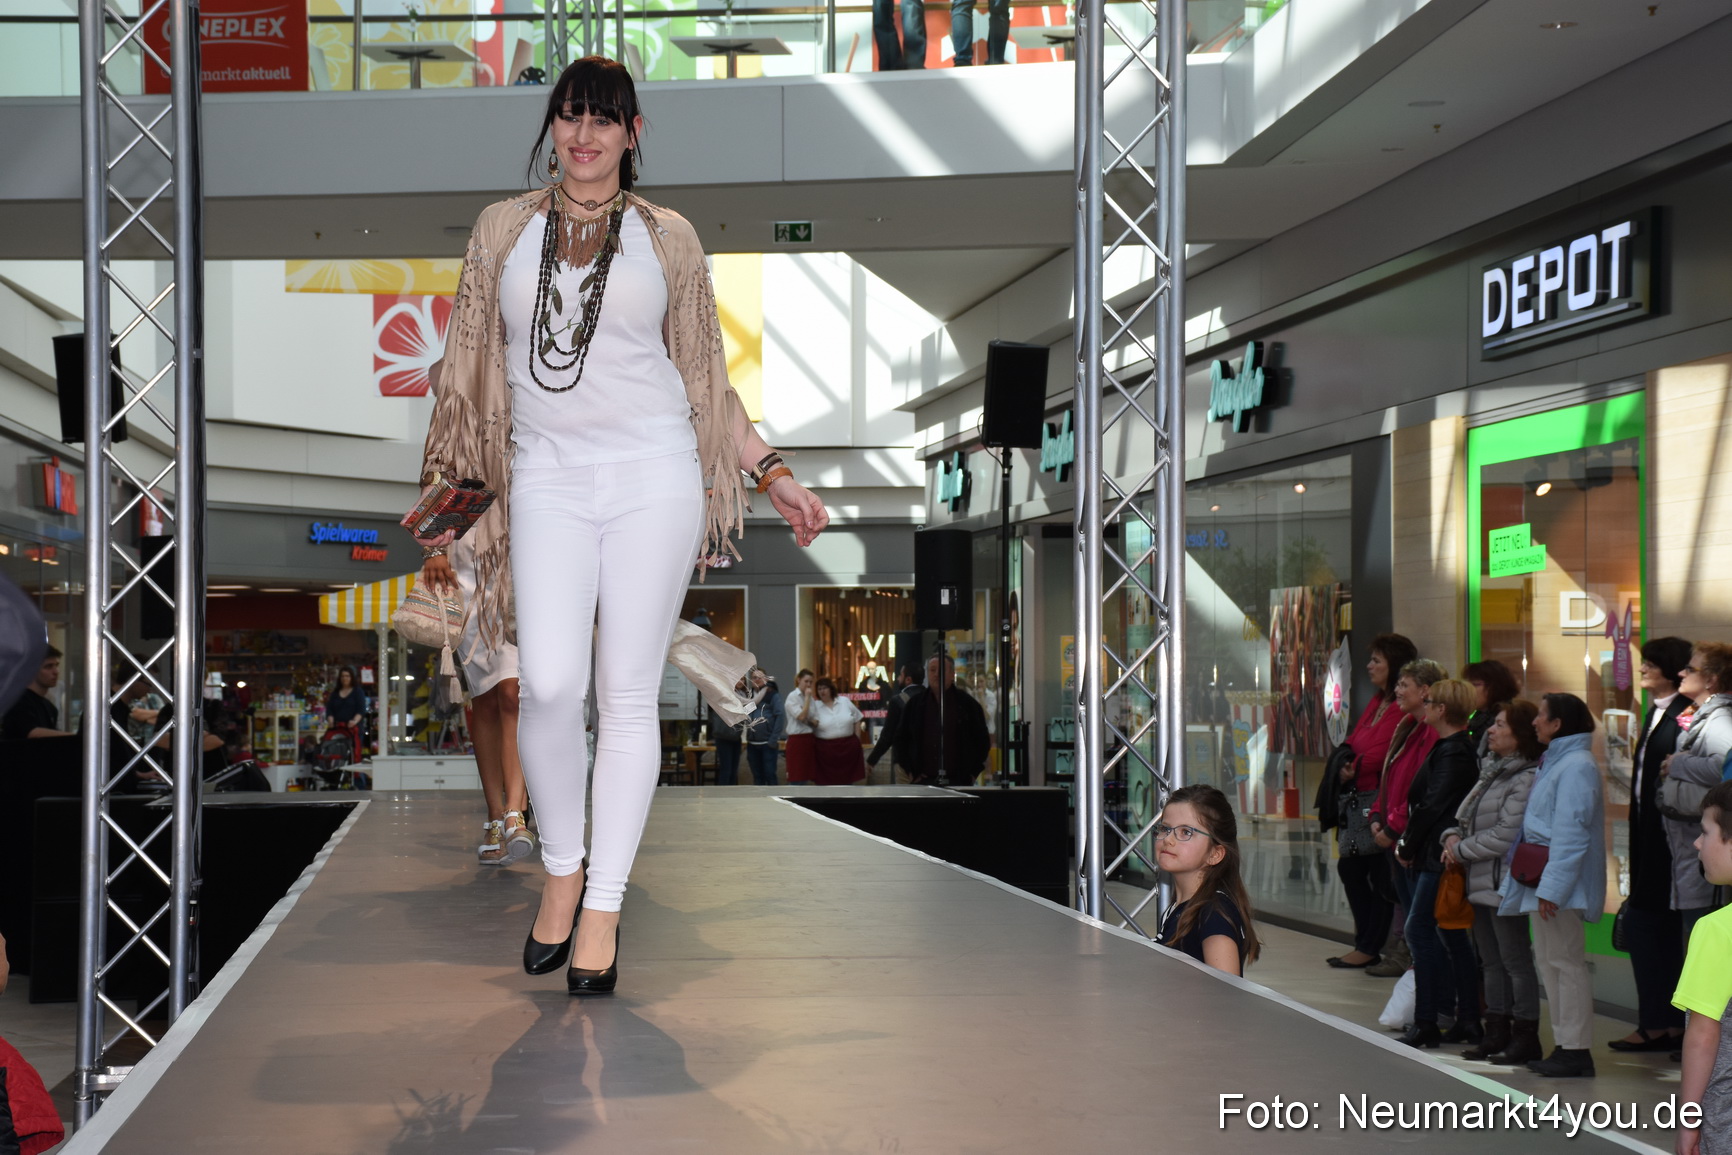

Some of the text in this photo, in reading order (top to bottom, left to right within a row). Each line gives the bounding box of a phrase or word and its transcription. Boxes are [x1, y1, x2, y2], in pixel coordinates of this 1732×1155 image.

[1483, 220, 1632, 337] DEPOT
[312, 522, 378, 544] Spielwaren
[352, 546, 389, 561] Krömer
